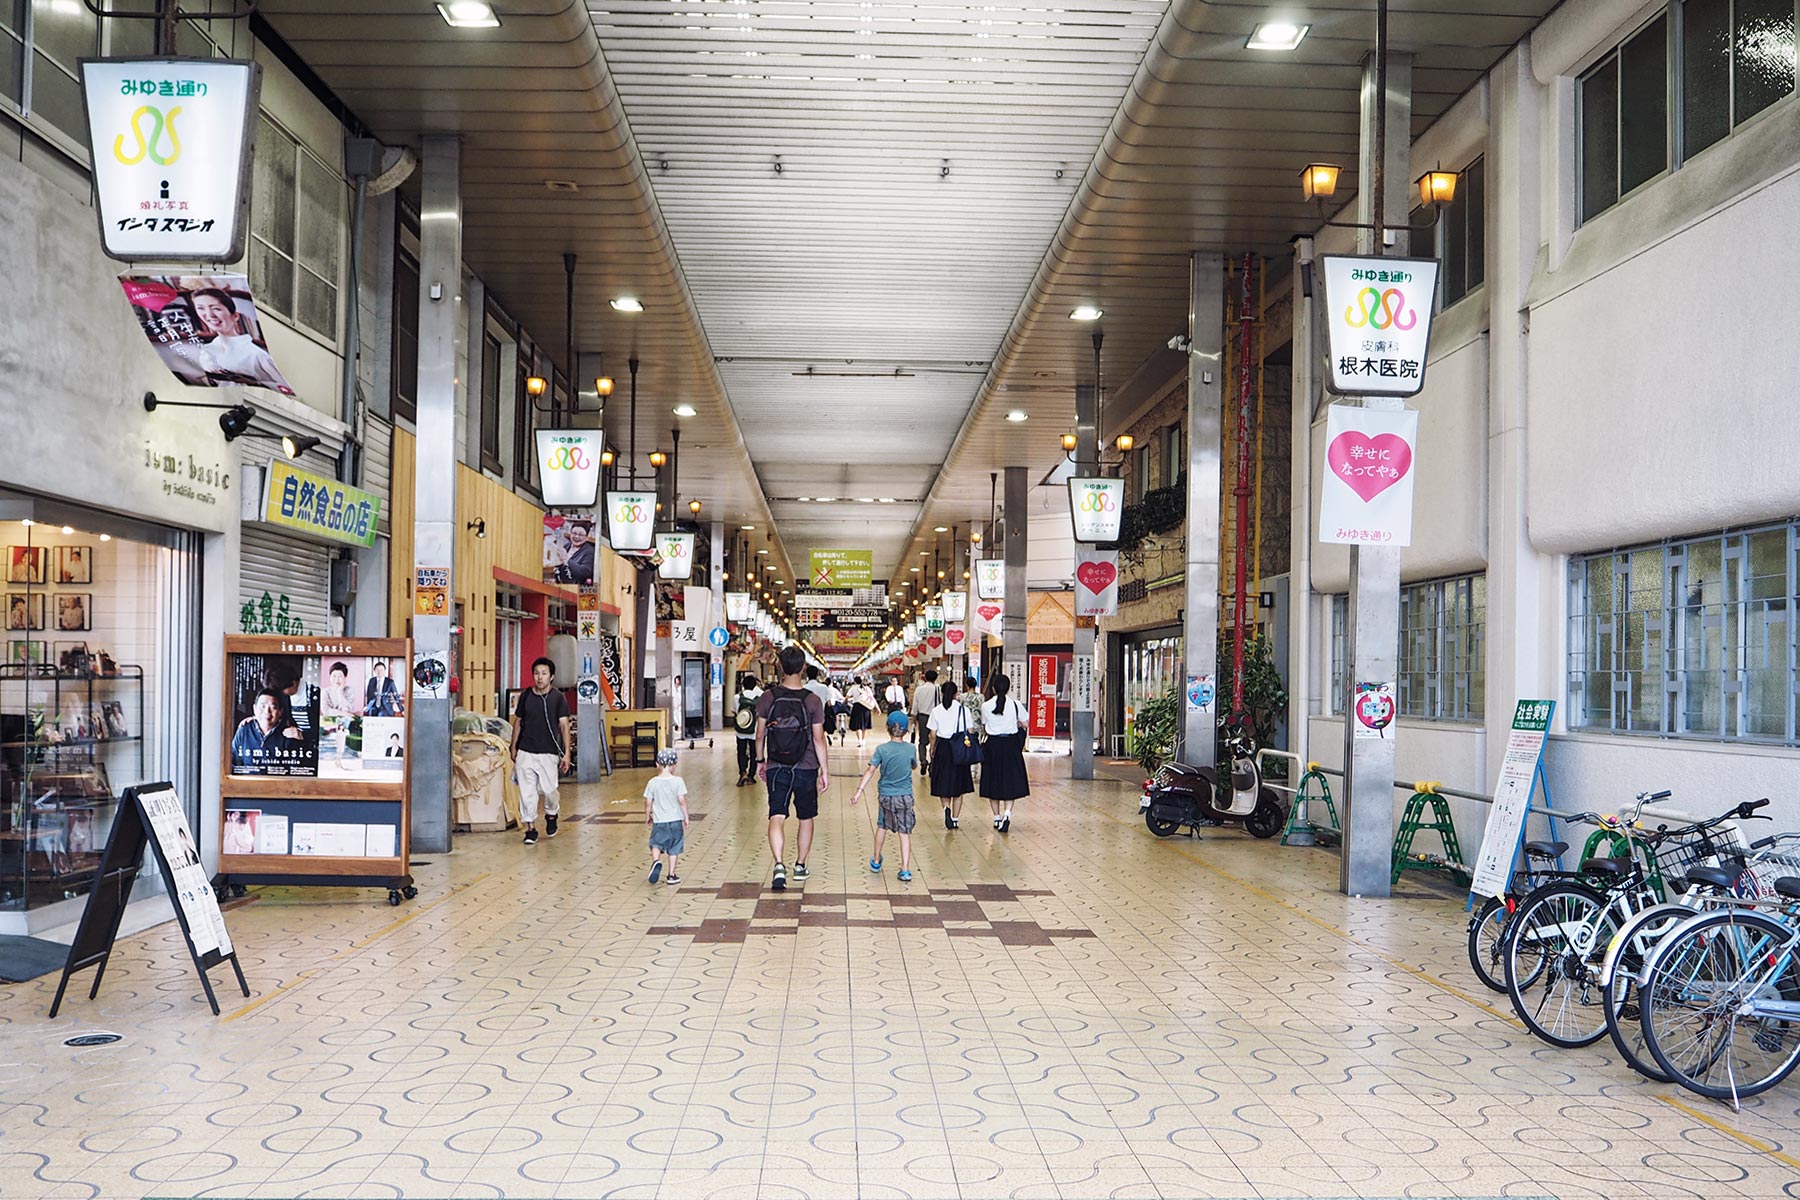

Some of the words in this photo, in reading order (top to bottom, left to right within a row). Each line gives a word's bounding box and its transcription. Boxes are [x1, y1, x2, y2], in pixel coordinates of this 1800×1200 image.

[120, 79, 208, 97] みゆき通り
[140, 200, 190, 211] 婚礼写真
[160, 217, 216, 233] スタジオ
[1351, 268, 1413, 284] みゆき通り
[1361, 339, 1400, 353] 皮膚科
[1338, 355, 1420, 379] 根木医院
[1349, 445, 1391, 461] 幸せに
[188, 453, 231, 491] basic
[1340, 461, 1400, 479] なってやぁ
[281, 474, 372, 538] 自然食品の店
[1335, 527, 1393, 543] みゆき通り
[281, 641, 313, 653] ism:
[315, 642, 353, 654] basic
[1516, 703, 1550, 720] 社会実験
[237, 745, 271, 757] ism:
[274, 746, 313, 759] basic
